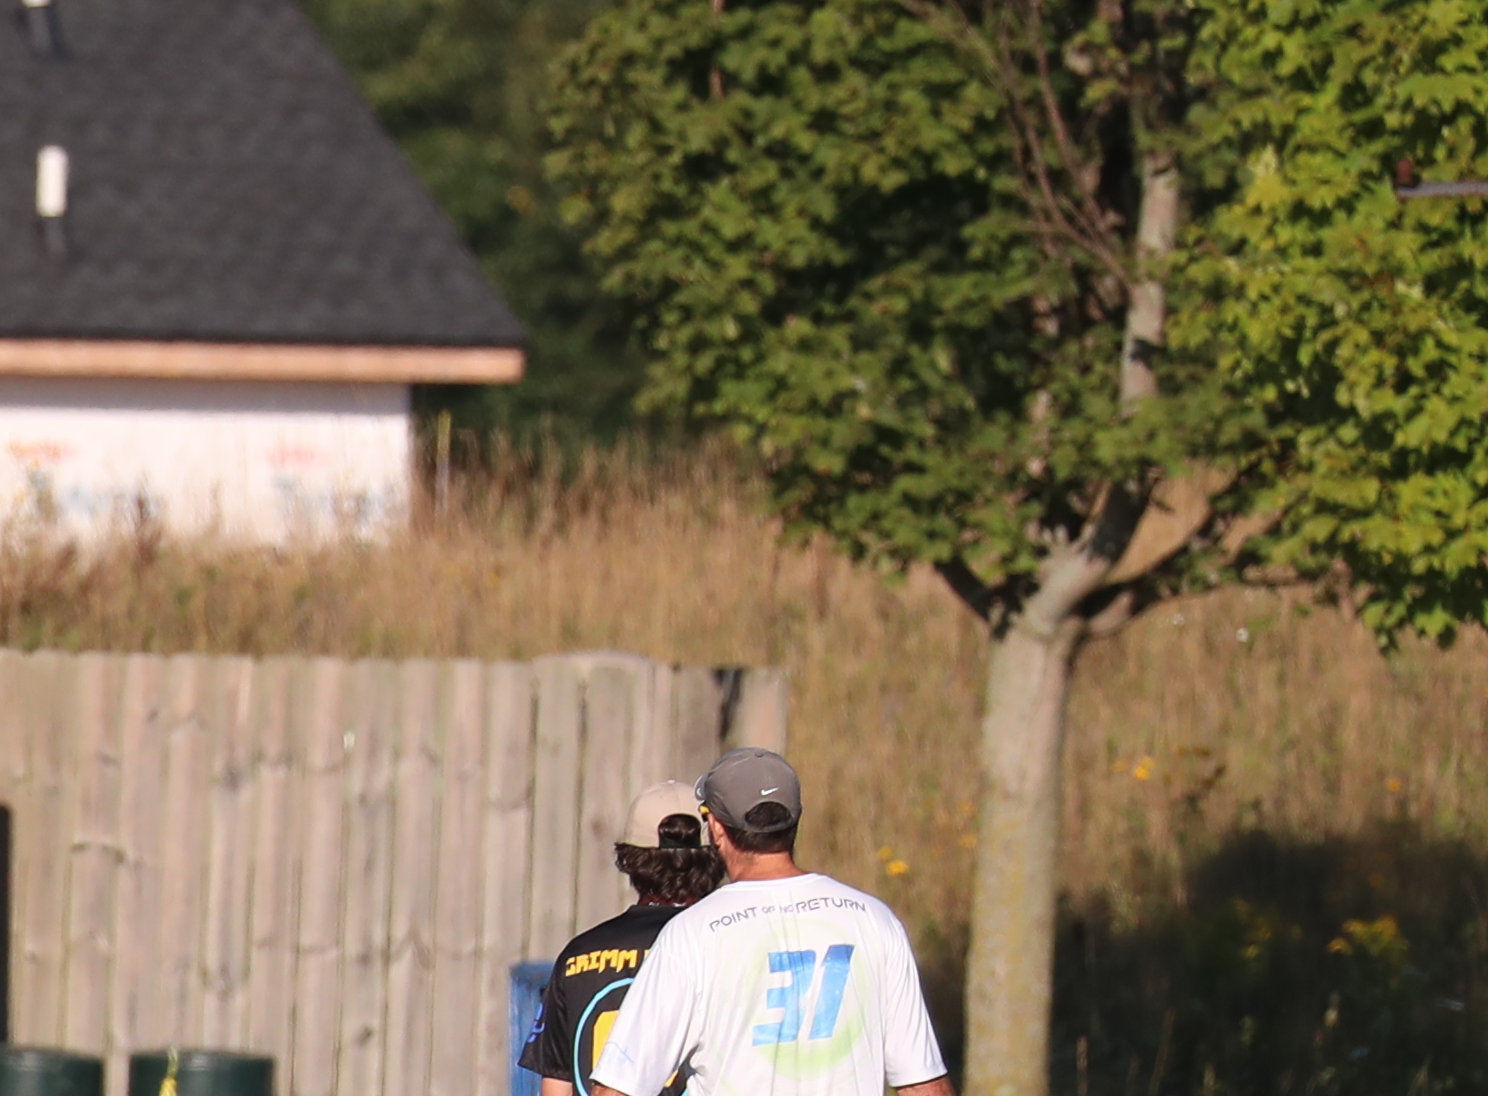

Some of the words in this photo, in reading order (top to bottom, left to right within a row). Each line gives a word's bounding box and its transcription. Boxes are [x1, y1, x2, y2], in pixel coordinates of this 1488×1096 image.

[708, 906, 758, 932] POINT
[795, 896, 867, 915] RETURN
[565, 949, 638, 977] GRIMM
[751, 943, 856, 1047] 31
